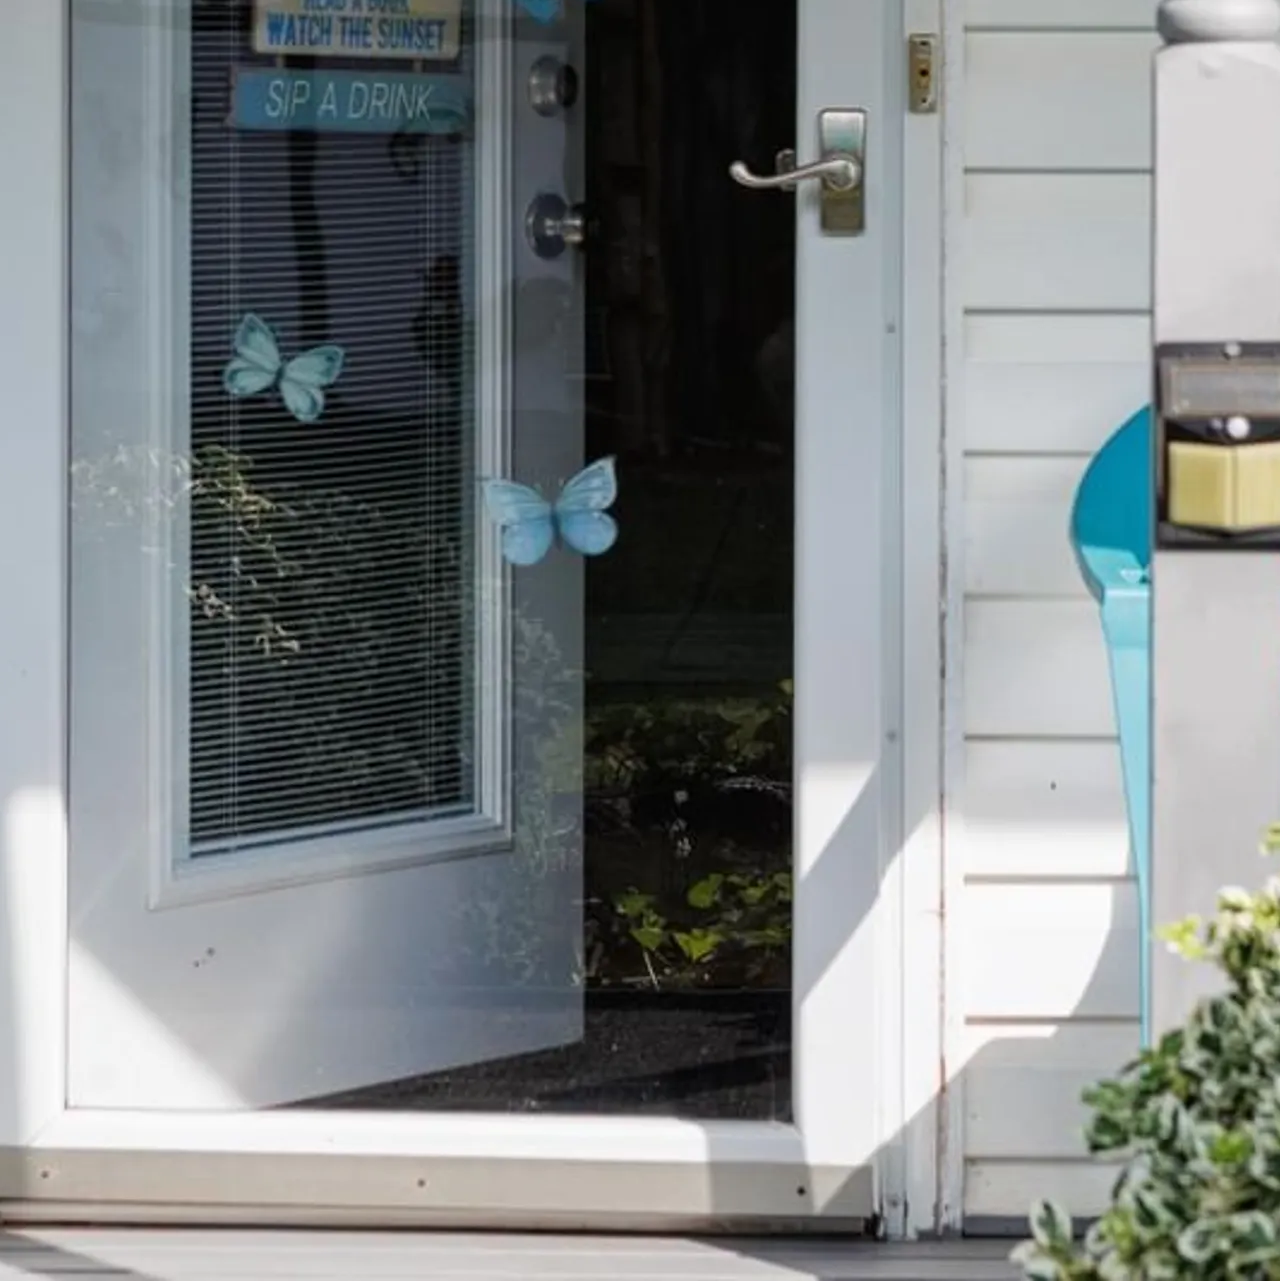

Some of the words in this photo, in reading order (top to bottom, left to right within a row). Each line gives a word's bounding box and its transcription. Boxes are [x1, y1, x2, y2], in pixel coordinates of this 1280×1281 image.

[266, 12, 332, 47] WATCH
[338, 16, 373, 49] THE
[377, 17, 447, 51] SUNSET
[264, 79, 311, 122] SIP
[316, 80, 338, 119] A
[346, 81, 434, 122] DRINK
